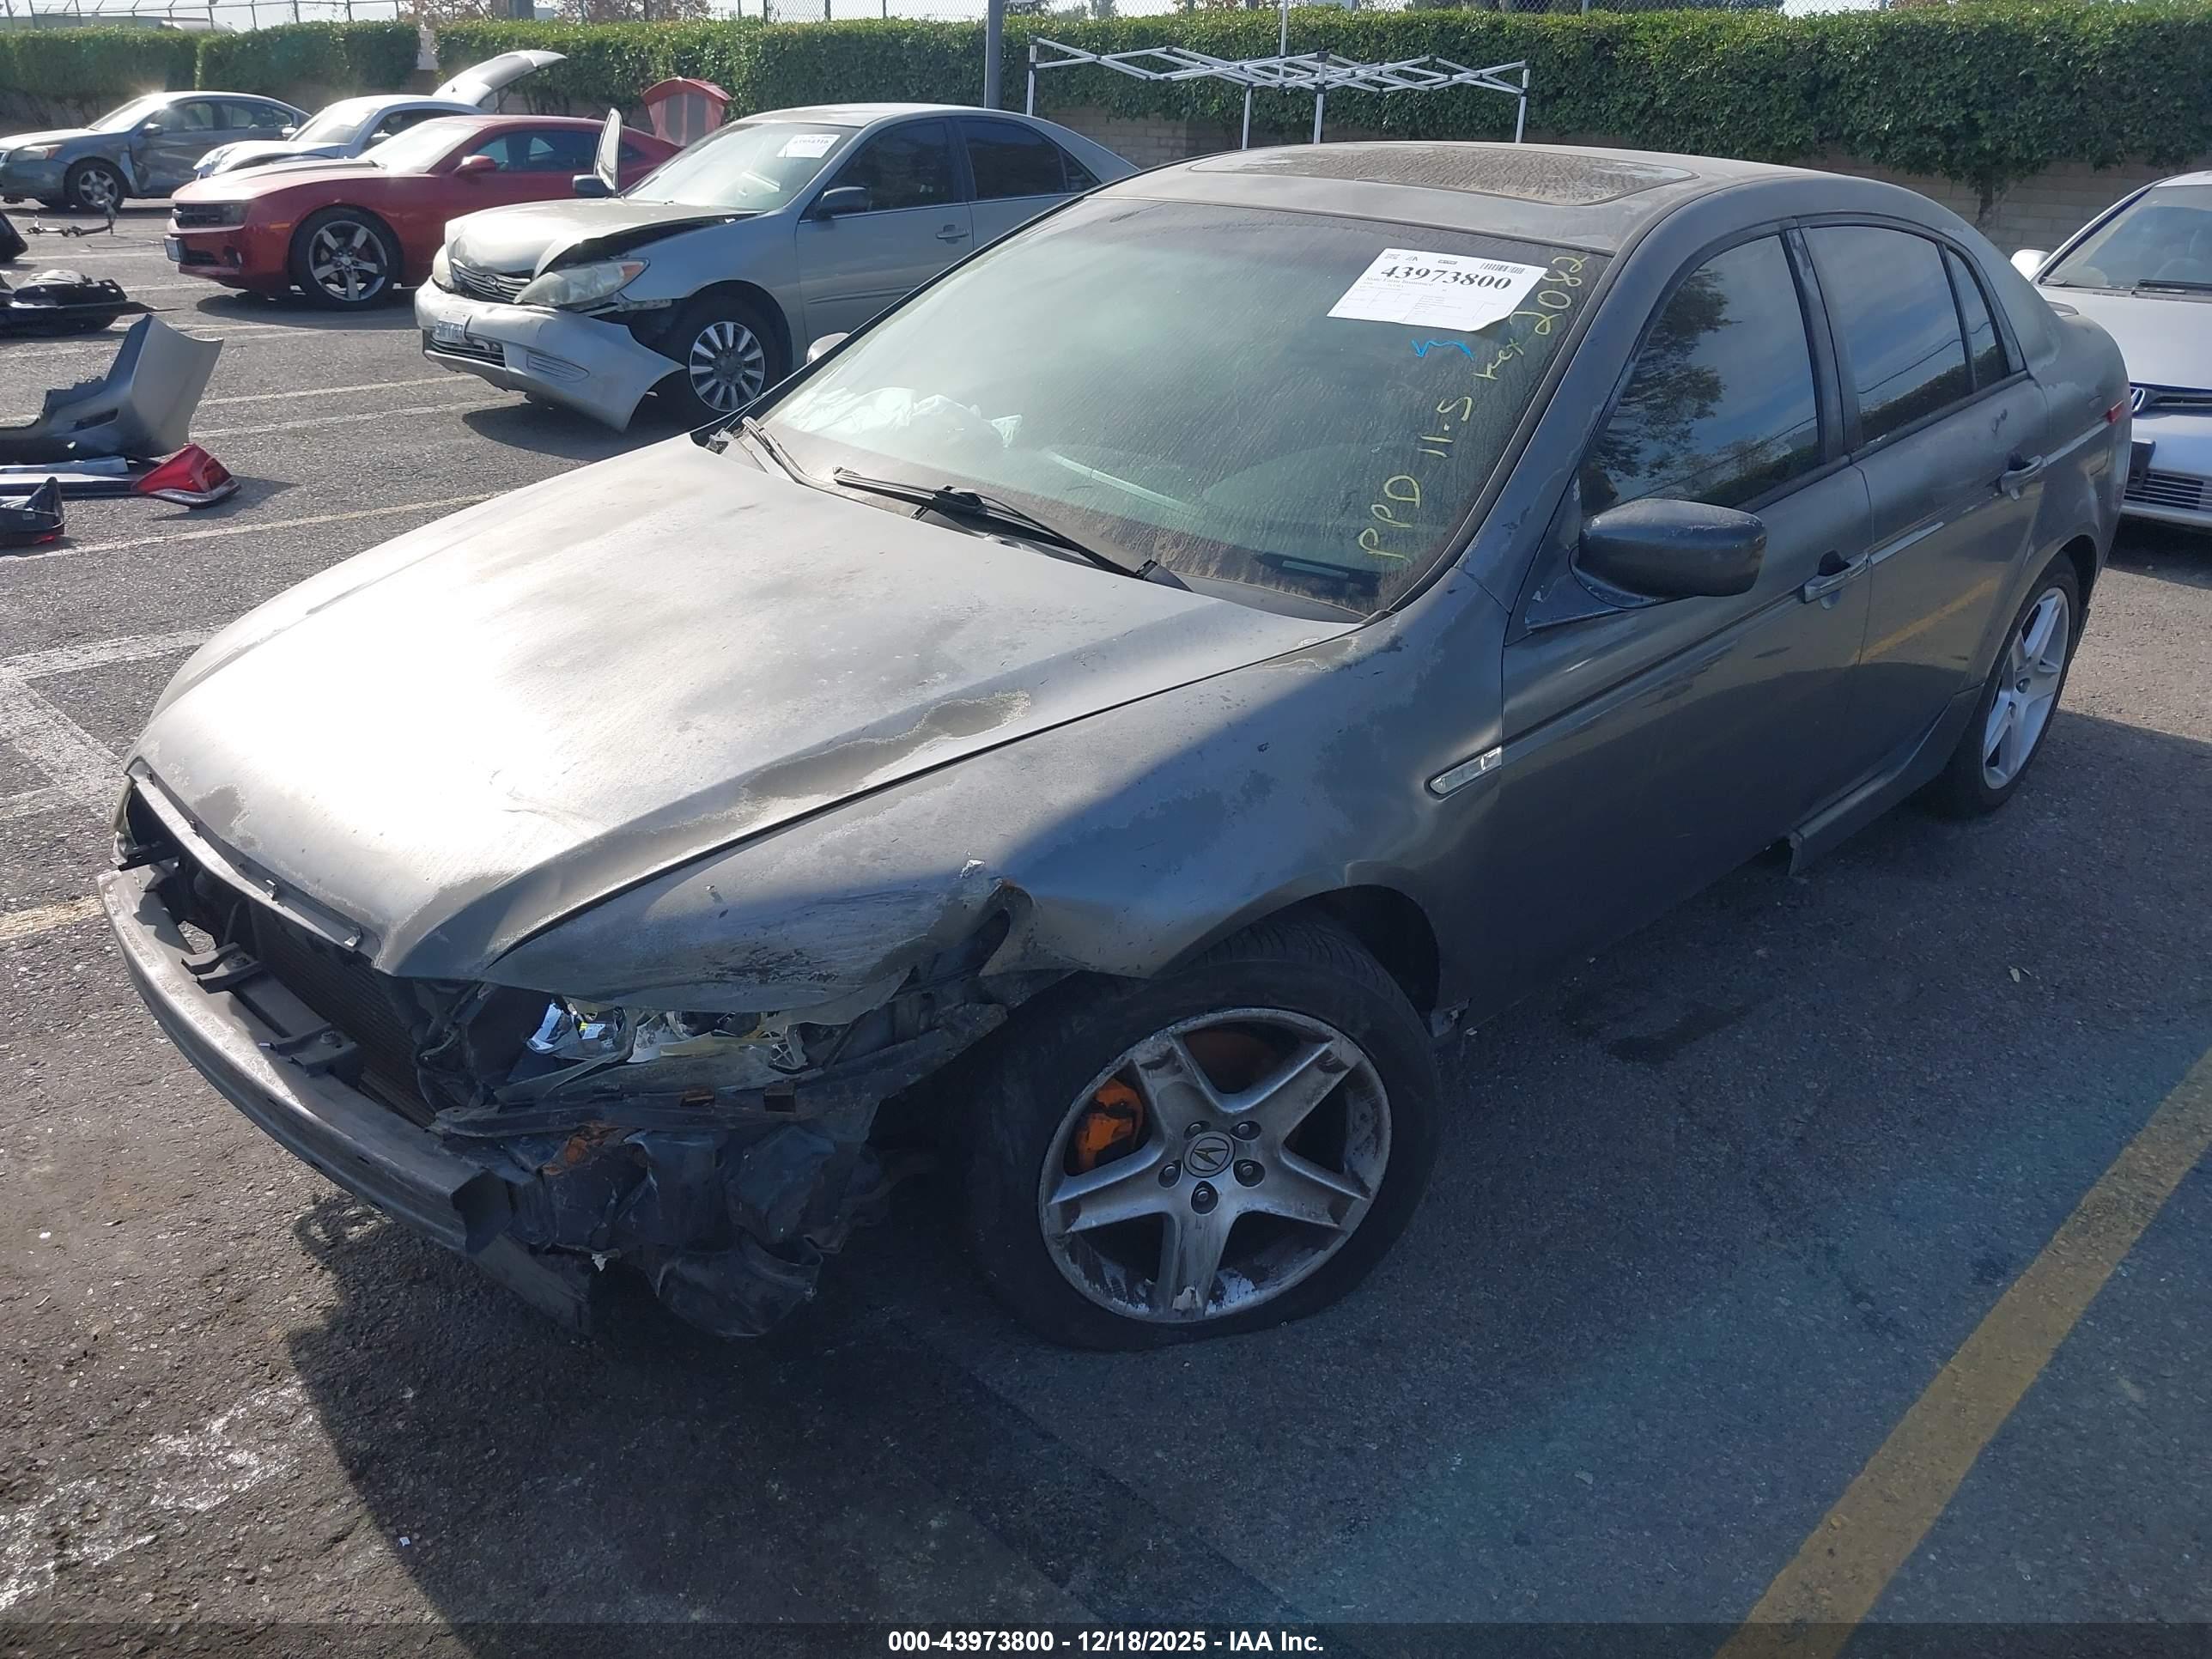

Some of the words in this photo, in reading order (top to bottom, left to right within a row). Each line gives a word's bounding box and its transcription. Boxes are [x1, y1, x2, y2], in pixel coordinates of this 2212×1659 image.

[1380, 264, 1512, 290] 43973800
[1358, 475, 1421, 564] PPD
[1510, 256, 1589, 336] 2082
